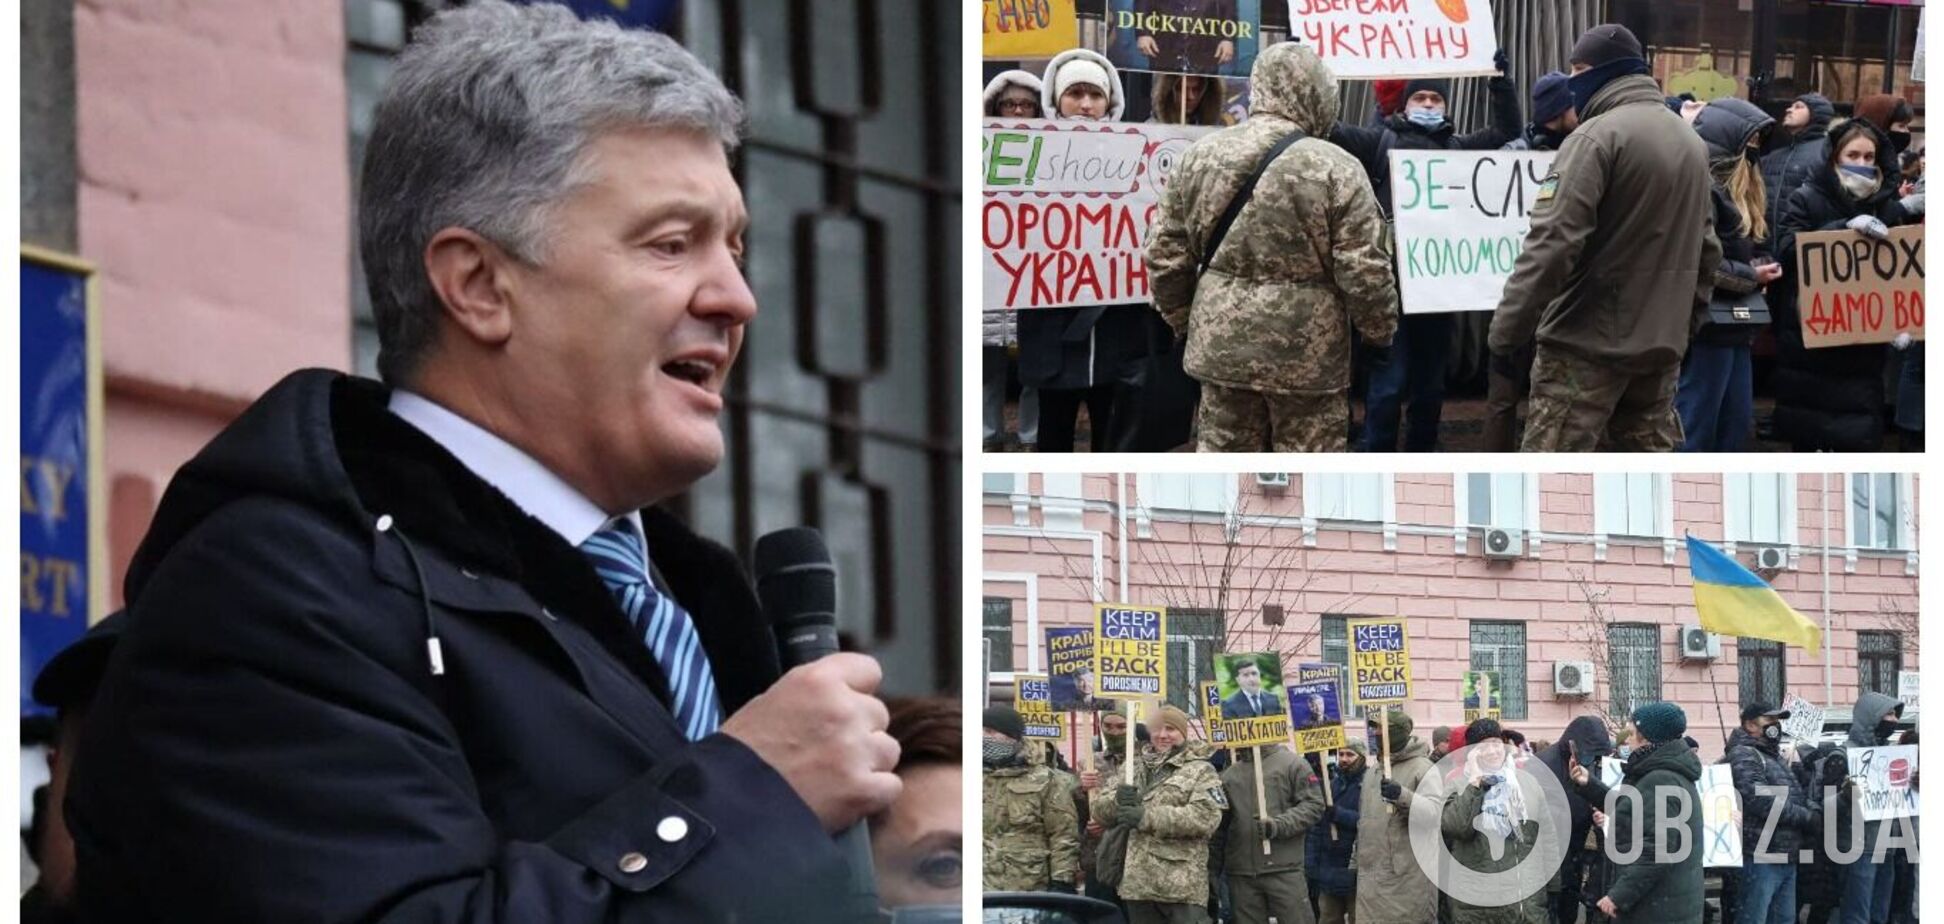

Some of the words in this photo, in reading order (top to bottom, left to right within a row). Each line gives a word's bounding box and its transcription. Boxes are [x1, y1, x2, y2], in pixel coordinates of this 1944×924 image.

[1304, 20, 1469, 58] УКРАЇНУ
[1038, 138, 1138, 182] show
[1802, 238, 1925, 287] ПОРОХ
[1805, 291, 1883, 335] ДАМО
[1106, 609, 1156, 627] KEEP
[1106, 625, 1156, 641] CALM
[1357, 624, 1398, 639] KEEP
[1101, 640, 1131, 656] I'LL
[1137, 642, 1160, 657] BE
[1359, 638, 1400, 651] CALM
[1101, 657, 1160, 674] BACK
[1355, 653, 1381, 667] I'LL
[1385, 652, 1405, 666] BE
[1357, 667, 1405, 683] BACK
[1102, 676, 1159, 692] POROSHENKO
